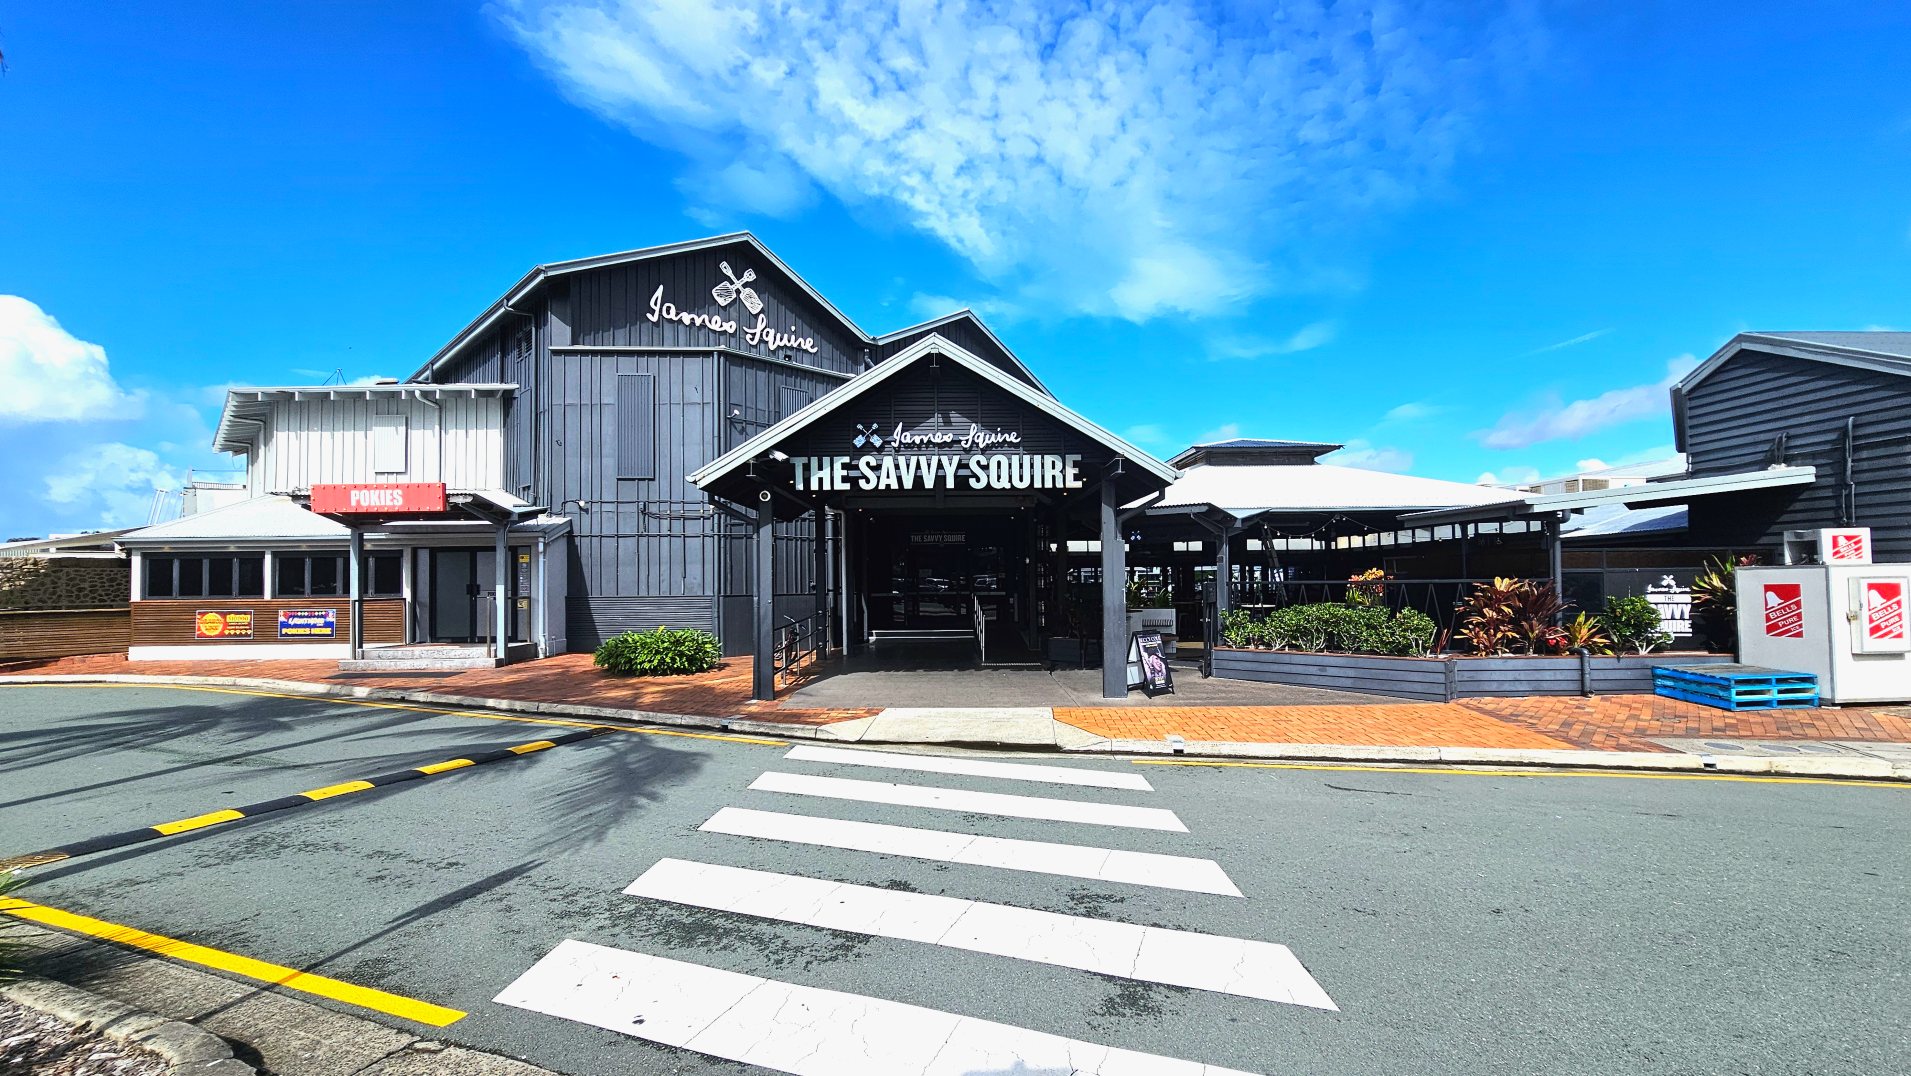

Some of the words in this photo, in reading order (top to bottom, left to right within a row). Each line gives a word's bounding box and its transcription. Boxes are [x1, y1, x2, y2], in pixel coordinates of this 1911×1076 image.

[646, 284, 737, 333] James
[743, 314, 818, 353] Squire
[891, 421, 953, 448] James
[959, 423, 1021, 448] Squire
[790, 456, 850, 491] THE
[858, 455, 960, 491] SAVVY
[968, 454, 1083, 490] SQUIRE
[350, 489, 403, 507] POKIES
[911, 535, 922, 543] THE
[923, 534, 942, 542] SAVVY
[943, 534, 966, 542] SQUIRE
[1769, 603, 1798, 620] BELLS
[1871, 603, 1899, 621] BELLS
[1778, 615, 1800, 628] PURE
[1880, 615, 1901, 629] PURE
